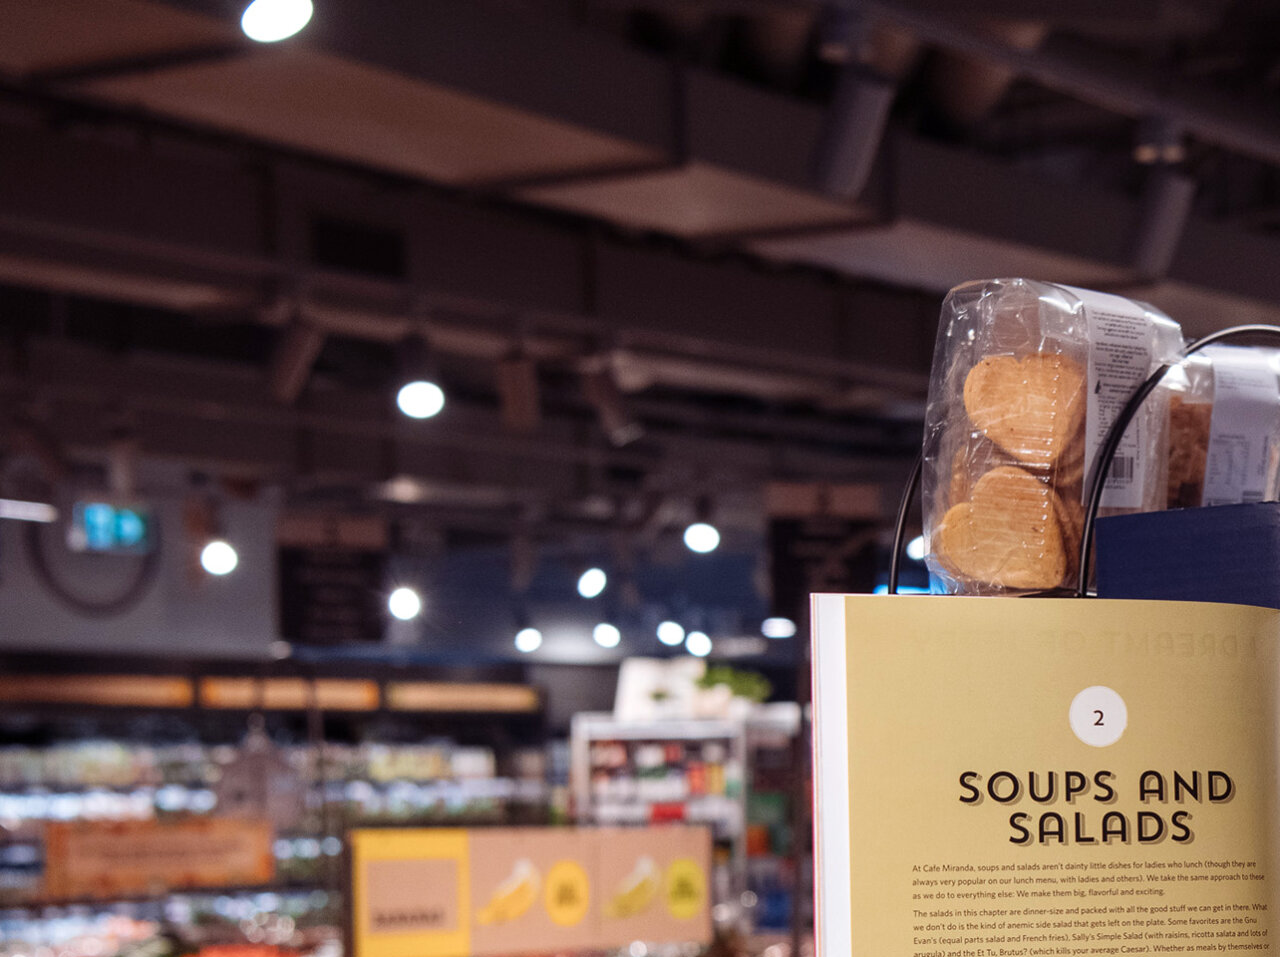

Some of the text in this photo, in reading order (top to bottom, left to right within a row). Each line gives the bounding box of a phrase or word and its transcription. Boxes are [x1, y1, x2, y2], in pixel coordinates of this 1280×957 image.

[1093, 709, 1105, 727] 2
[959, 770, 1235, 805] SOUPS AND
[1009, 811, 1195, 846] SALADS
[922, 864, 940, 872] Cafe
[942, 864, 975, 872] Miranda,
[1065, 863, 1087, 871] dainty
[1204, 860, 1230, 870] (though
[1231, 860, 1245, 869] they
[912, 878, 938, 887] always
[957, 877, 986, 886] popular
[1116, 874, 1144, 884] others).
[1210, 873, 1240, 883] approach
[956, 891, 995, 900] everything
[1073, 889, 1086, 898] big,
[1135, 888, 1164, 897] exciting.
